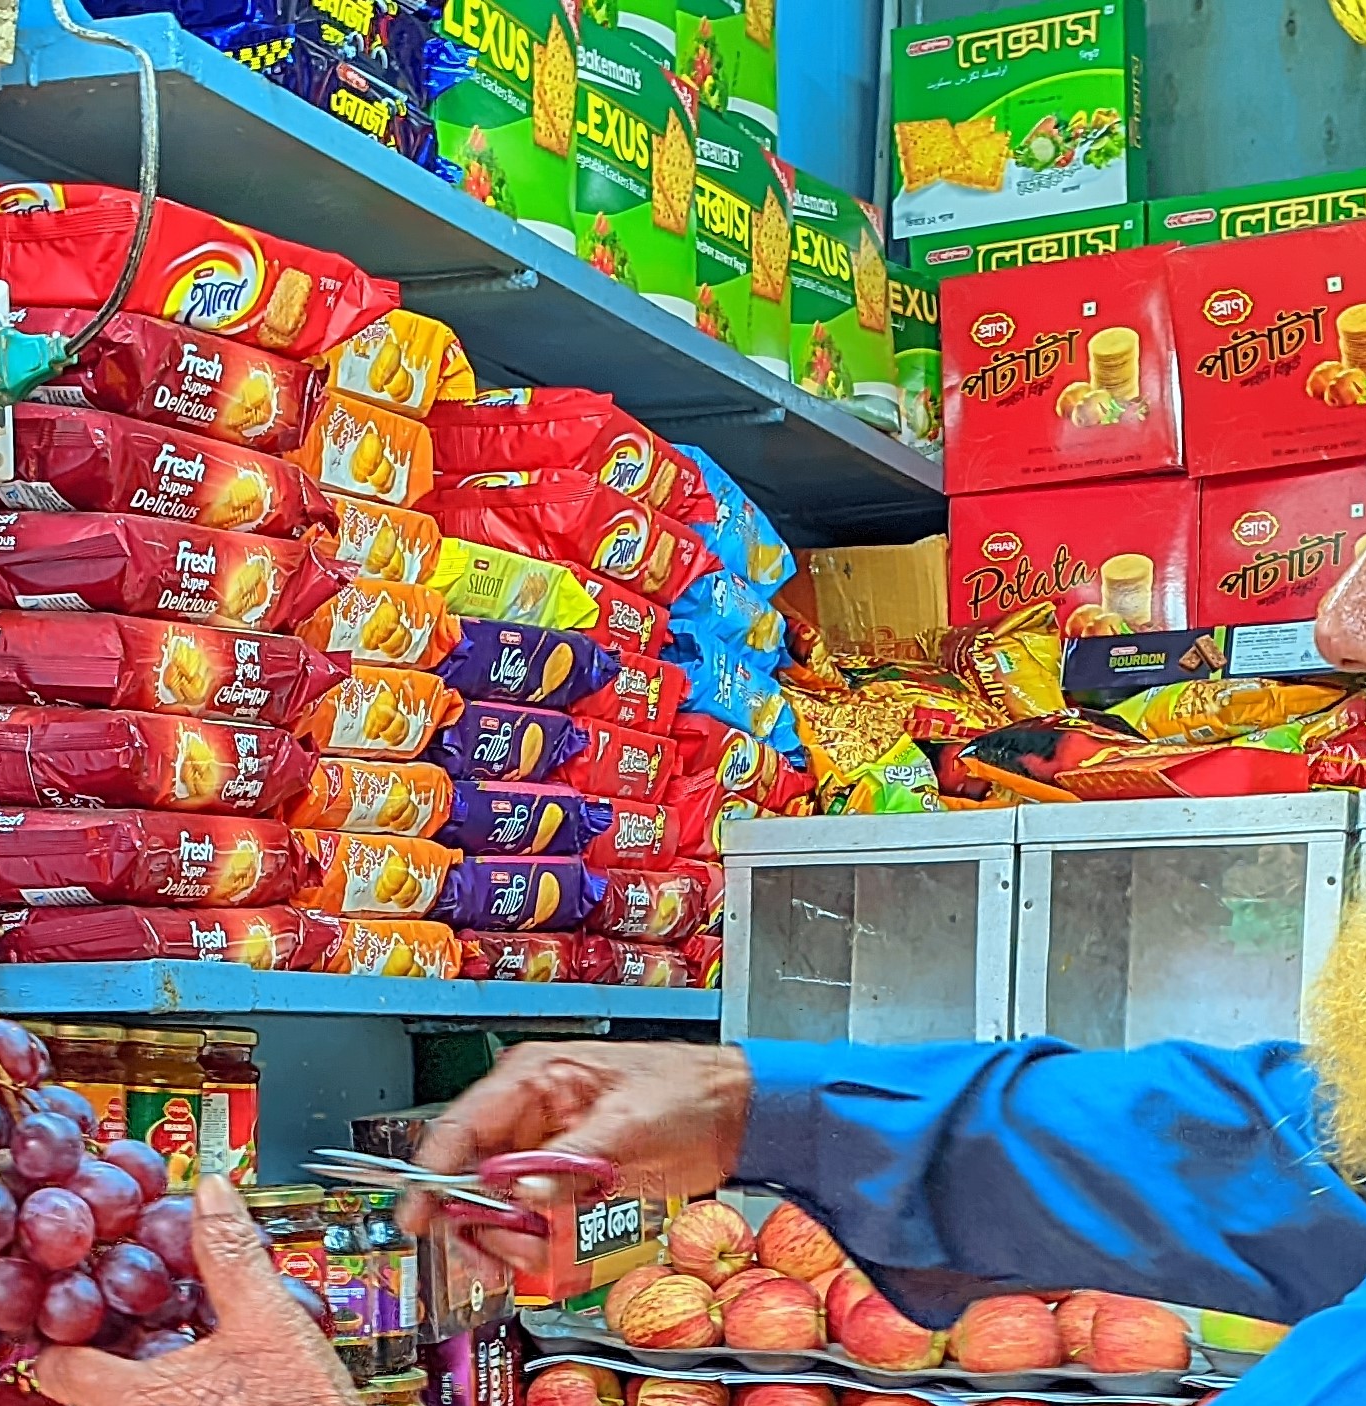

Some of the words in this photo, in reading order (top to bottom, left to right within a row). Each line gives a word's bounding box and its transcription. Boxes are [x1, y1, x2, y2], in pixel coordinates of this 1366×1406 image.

[443, 0, 531, 82] LEXUS
[955, 9, 1102, 68] লেক্সাস
[577, 152, 604, 177] egetable
[888, 281, 939, 324] EXU
[1210, 297, 1245, 318] প্রাণ
[977, 320, 1009, 340] প্রাণ
[1196, 306, 1327, 383] পটাটা
[176, 343, 223, 384] Fresh
[960, 329, 1082, 401] পটাটা
[181, 376, 213, 398] Super
[153, 386, 218, 423] Delicious
[153, 443, 205, 483] Fresh
[158, 475, 194, 497] Super
[130, 489, 201, 520] Delicious
[1239, 517, 1272, 537] প্রাণ
[175, 540, 216, 575] Fresh
[986, 540, 1018, 554] PRAN
[181, 573, 211, 592] Super
[965, 543, 1100, 620] Potata
[1218, 530, 1347, 603] পটাটা
[157, 590, 219, 614] Delicious
[490, 647, 528, 693] Nutty
[1109, 652, 1166, 668] BOURBON
[180, 830, 214, 863] Fresh
[181, 862, 207, 879] Super
[495, 946, 525, 970] Fresh
[622, 952, 647, 976] Fresh
[579, 1201, 607, 1252] ড্রাই
[608, 1199, 639, 1240] কেক
